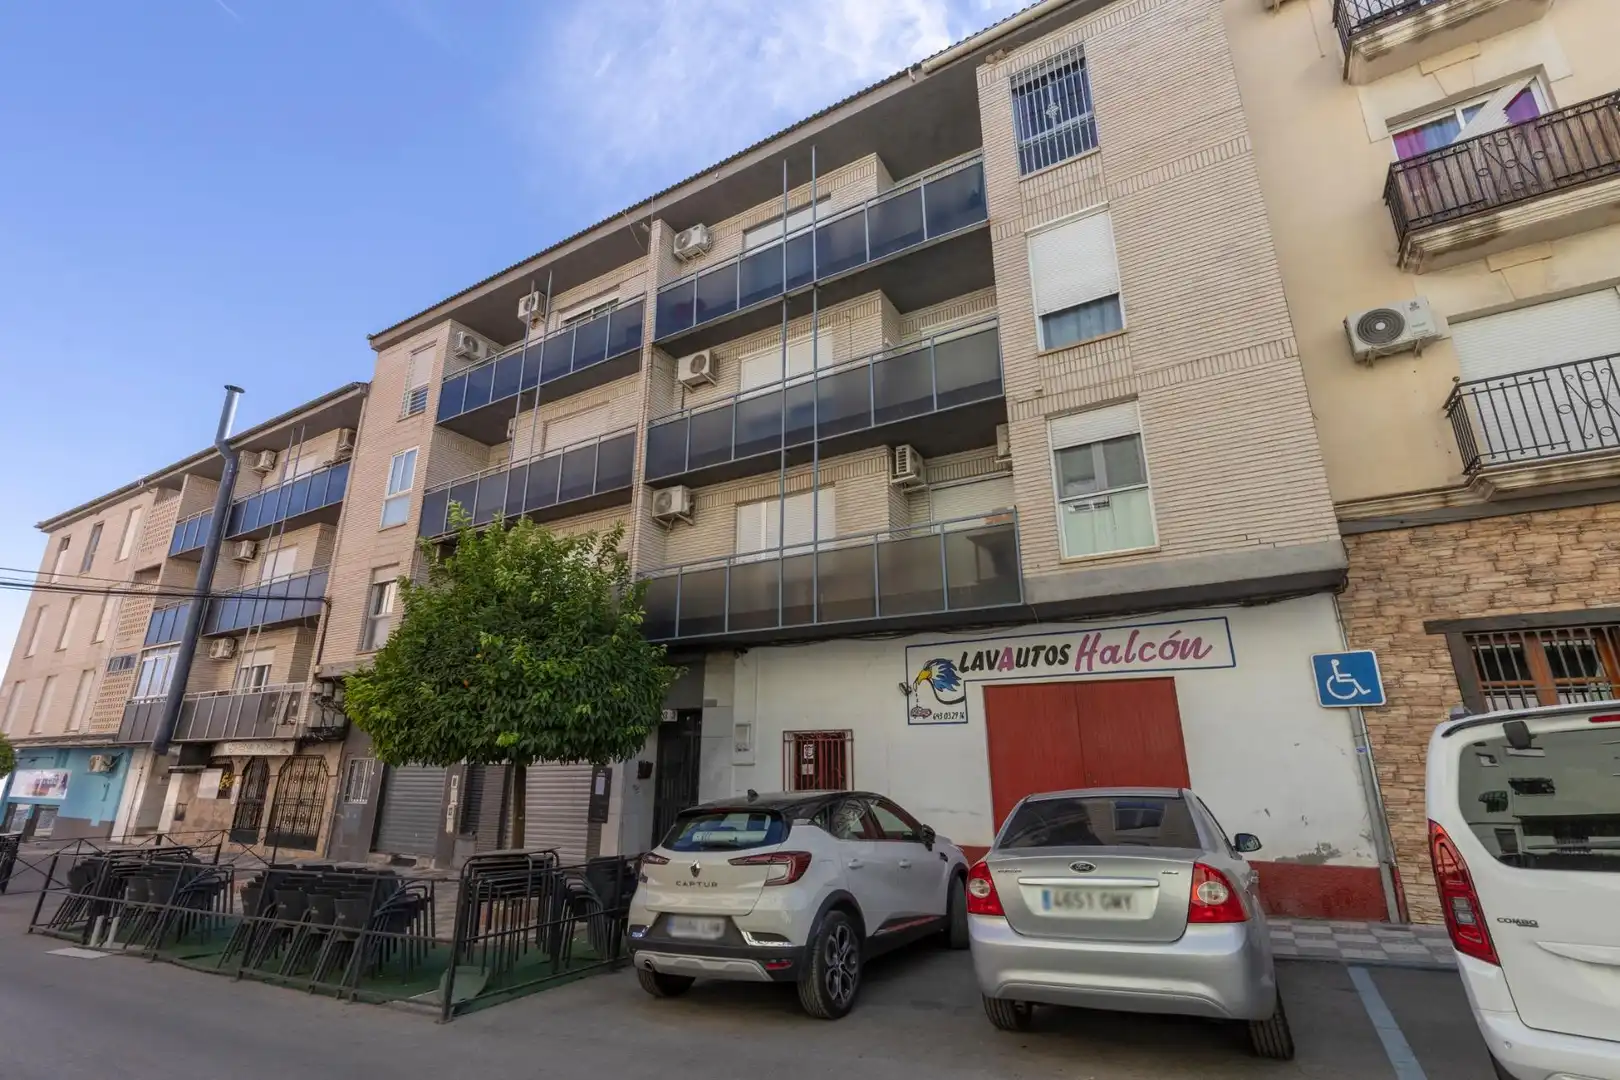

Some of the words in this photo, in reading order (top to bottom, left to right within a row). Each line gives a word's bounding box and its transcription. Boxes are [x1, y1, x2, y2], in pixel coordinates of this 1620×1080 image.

[958, 642, 1072, 673] LAVAUTOS
[1075, 629, 1213, 672] Halcón
[675, 879, 718, 888] CAPTUR
[1497, 917, 1539, 927] COMBO
